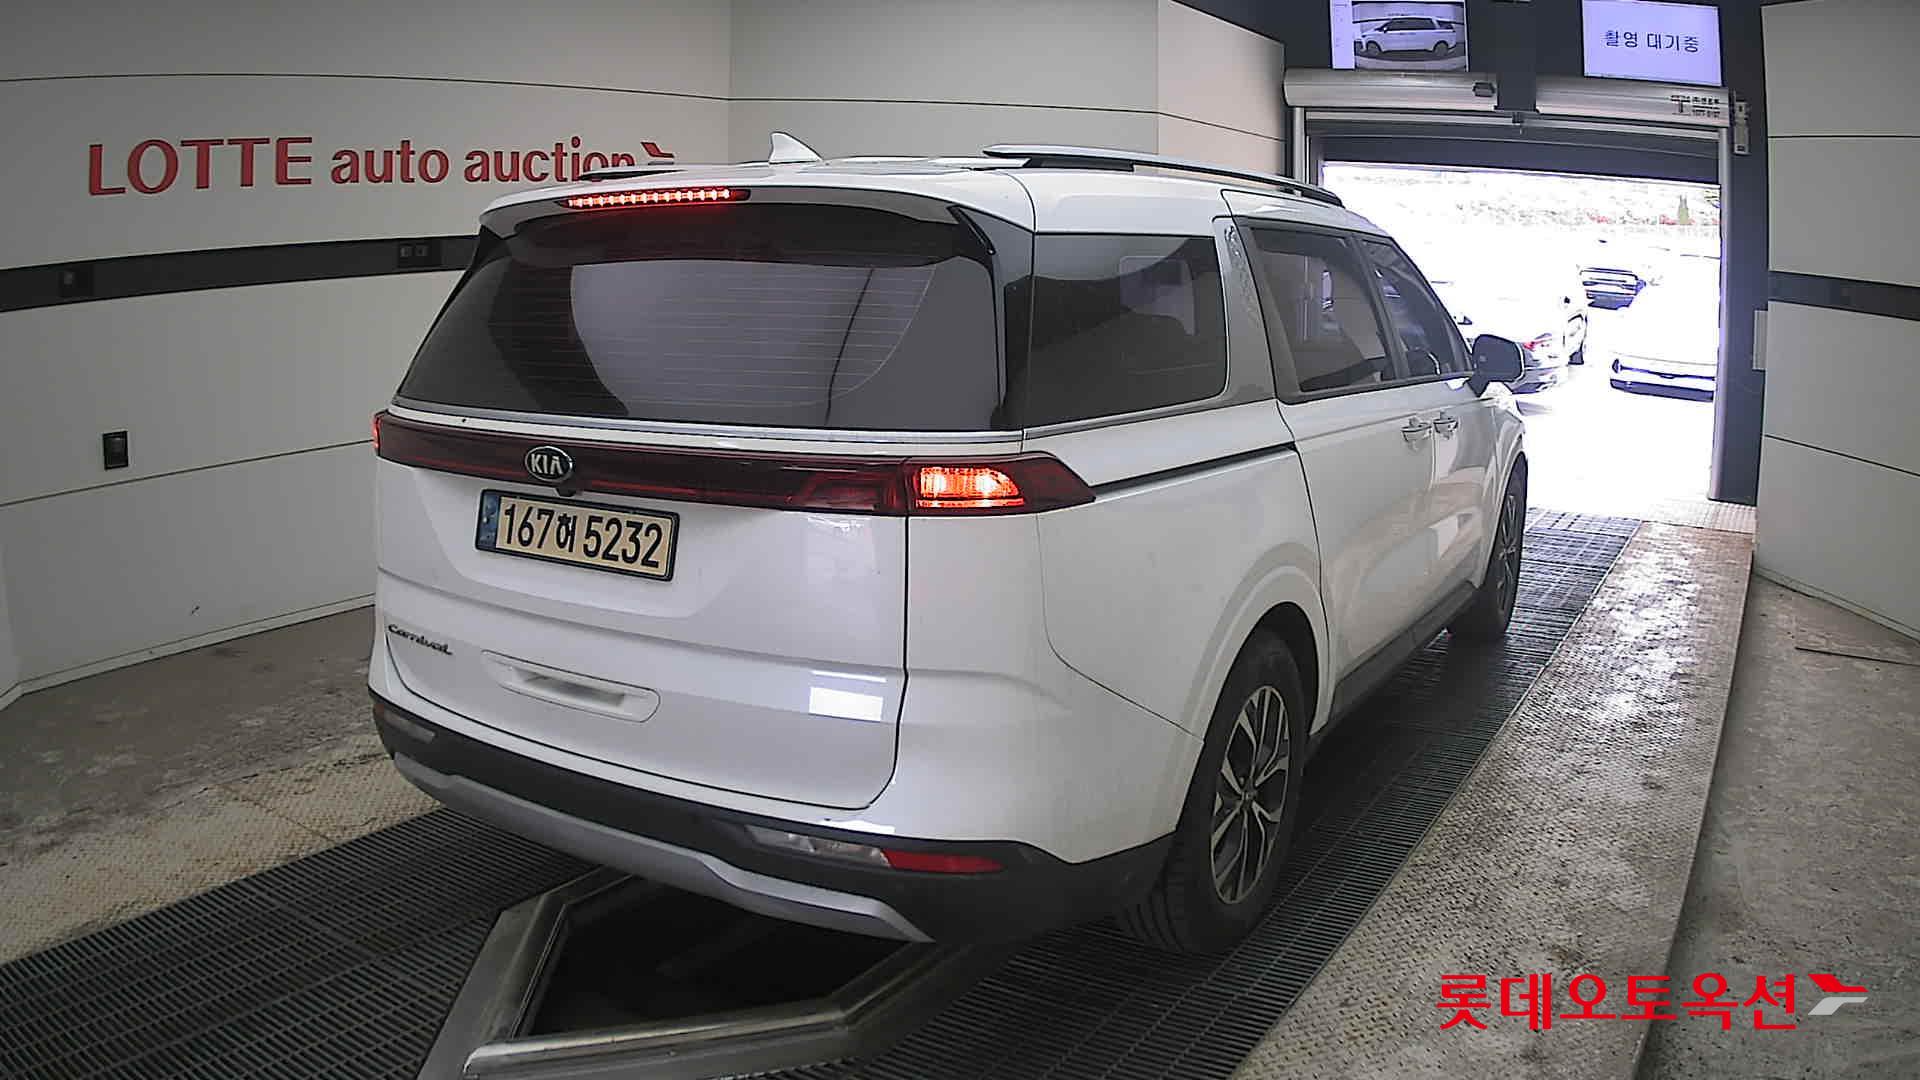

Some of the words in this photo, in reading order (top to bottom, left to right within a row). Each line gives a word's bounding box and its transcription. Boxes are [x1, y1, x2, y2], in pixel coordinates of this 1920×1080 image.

[89, 138, 312, 195] LOTTE
[330, 141, 450, 184] auto
[529, 457, 564, 478] KIA
